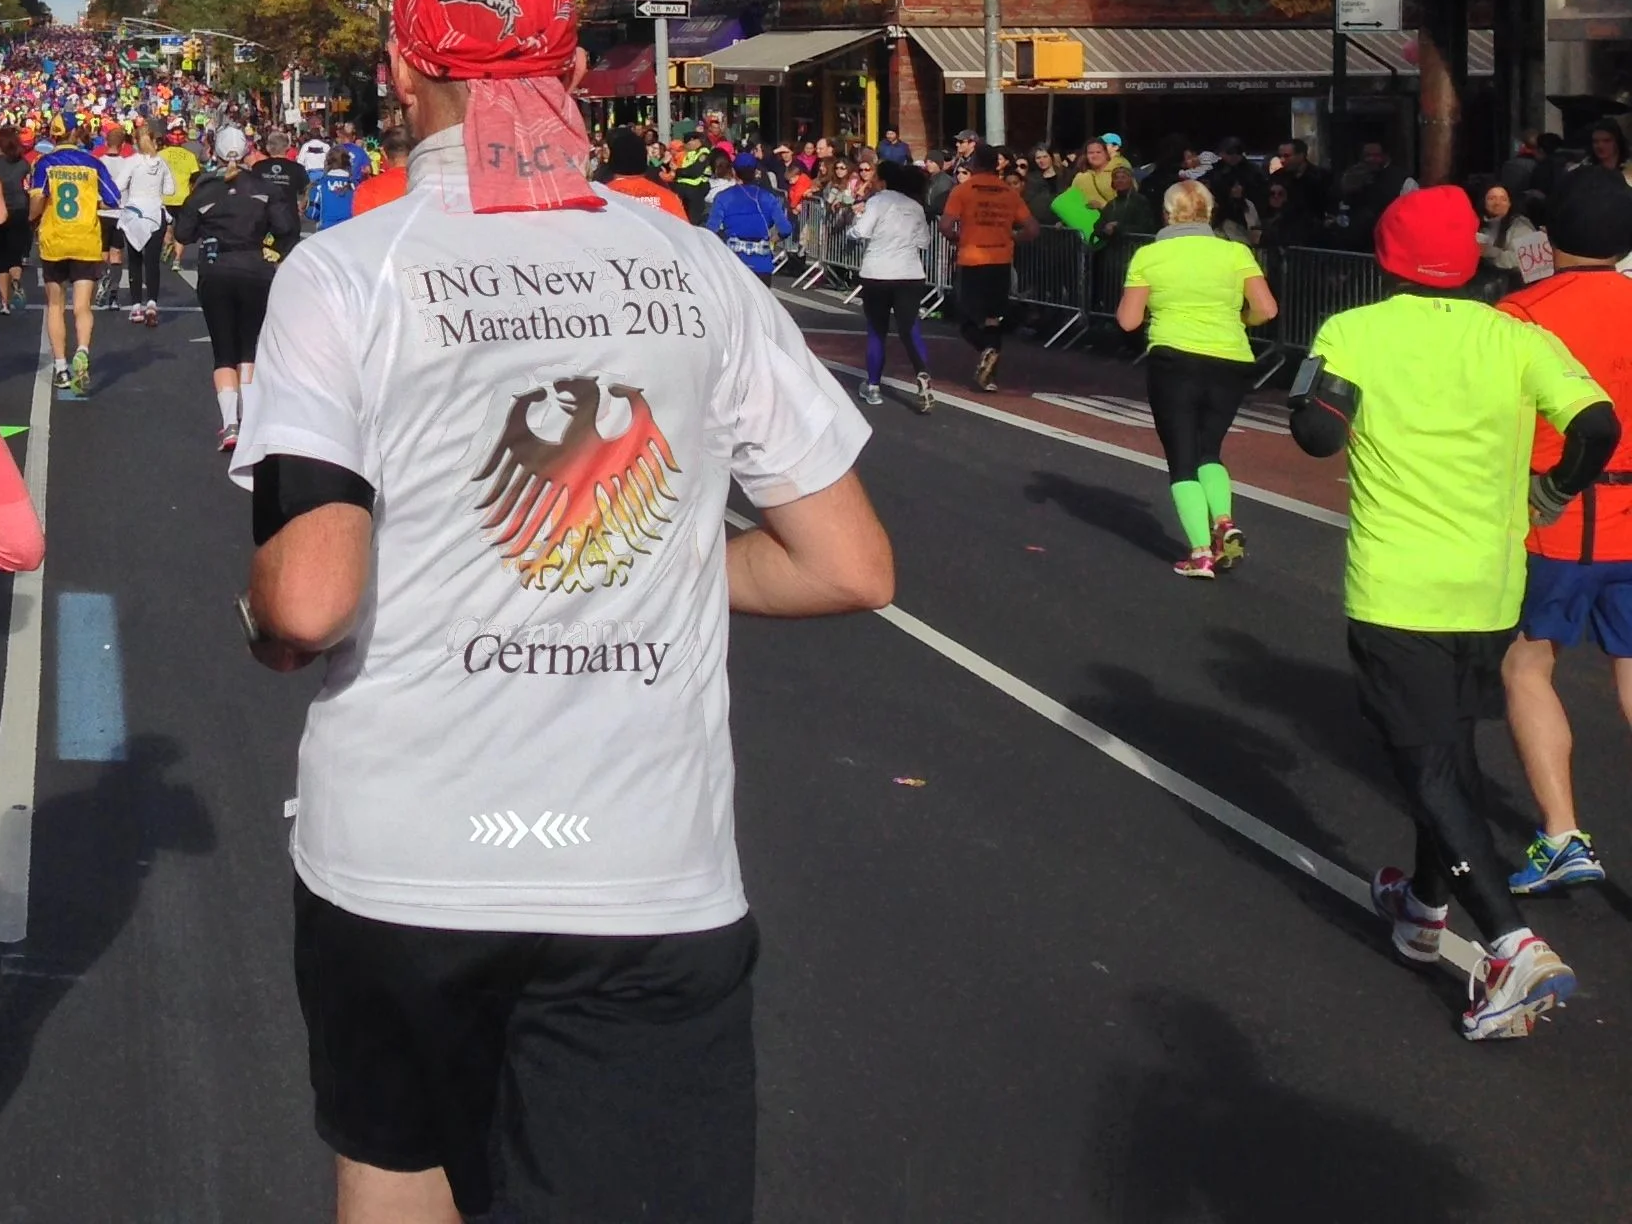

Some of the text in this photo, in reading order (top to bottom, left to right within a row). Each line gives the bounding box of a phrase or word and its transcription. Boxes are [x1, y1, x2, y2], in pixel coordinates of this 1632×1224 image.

[644, 4, 682, 13] ONE WAY
[1125, 80, 1167, 90] organic
[55, 182, 80, 220] 8
[419, 256, 696, 305] ING New York
[436, 300, 706, 348] Marathon 2013
[462, 633, 672, 687] Germany
